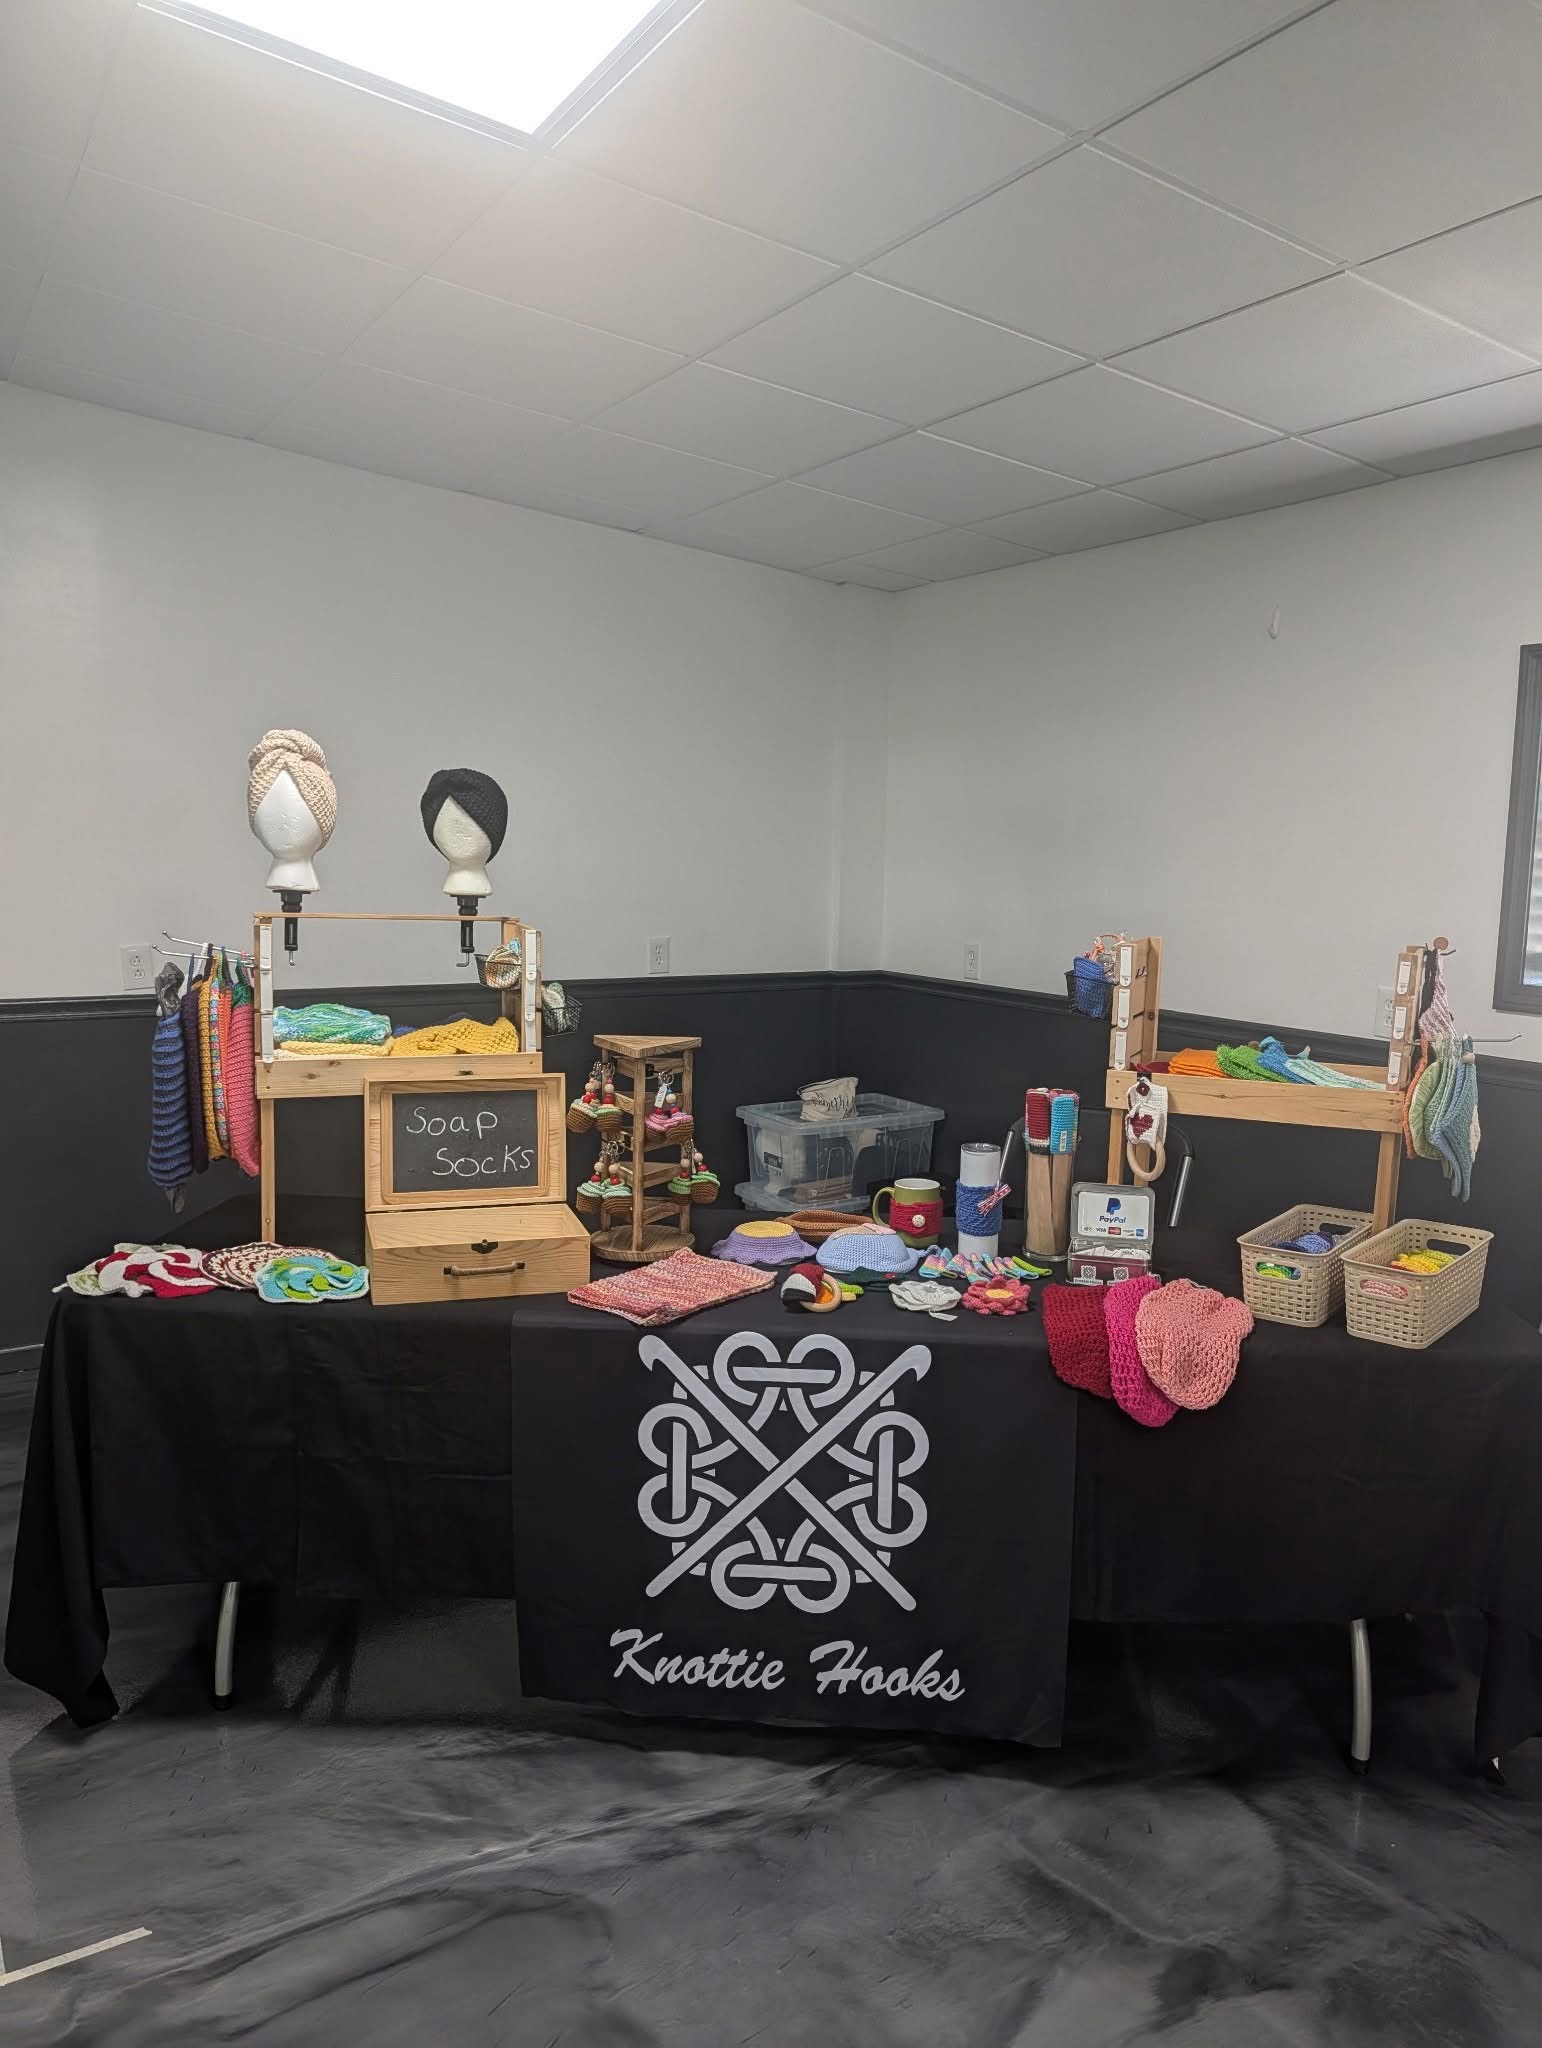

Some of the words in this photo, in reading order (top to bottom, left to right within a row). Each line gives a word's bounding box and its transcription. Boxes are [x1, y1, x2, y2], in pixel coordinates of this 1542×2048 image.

[405, 1106, 498, 1140] Soap
[432, 1144, 535, 1177] Socks
[1099, 1215, 1127, 1224] PayPal
[609, 1628, 786, 1690] Knottie
[809, 1639, 966, 1702] Hooks
